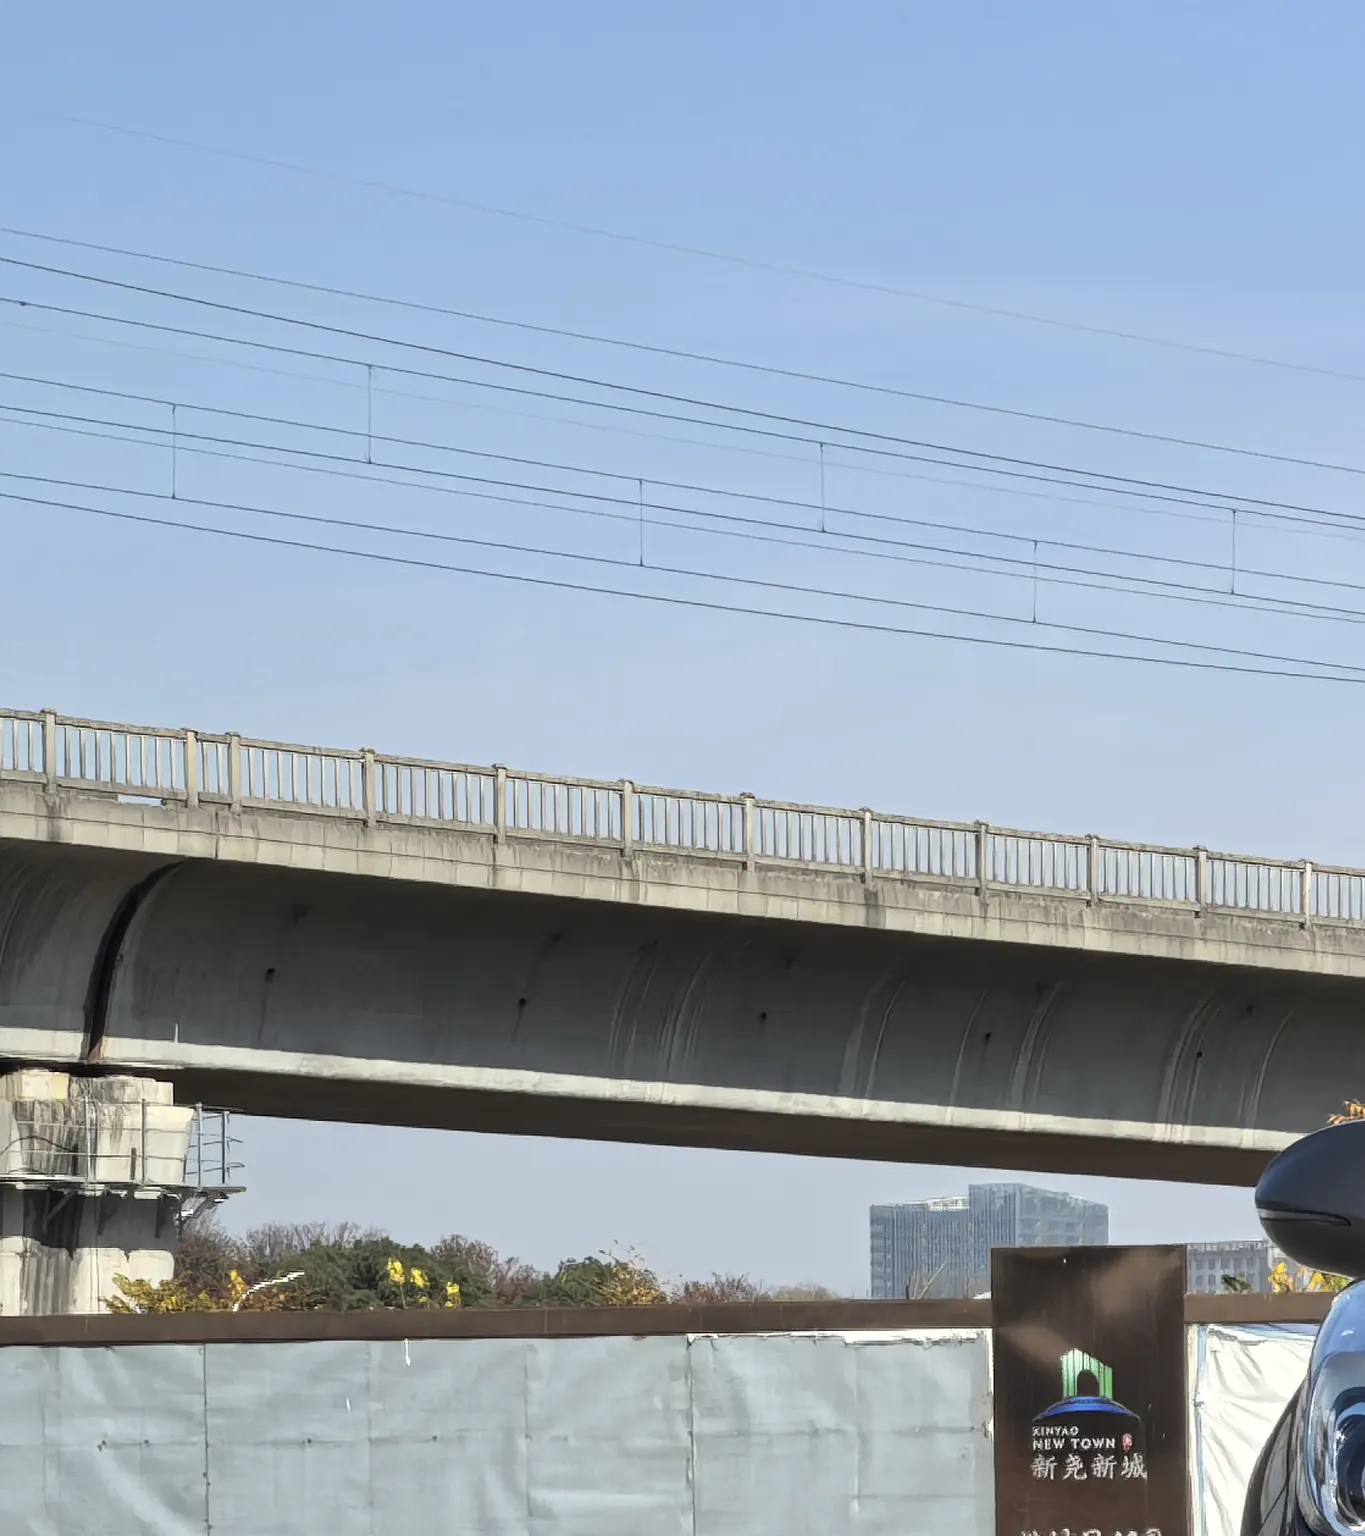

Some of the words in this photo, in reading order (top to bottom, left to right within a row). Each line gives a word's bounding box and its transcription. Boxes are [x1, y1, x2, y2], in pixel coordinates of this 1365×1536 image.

[1032, 1426, 1079, 1437] XINYAO
[1032, 1438, 1065, 1450] NEW
[1071, 1438, 1116, 1450] TOWN
[1030, 1453, 1148, 1480] 新尧新城
